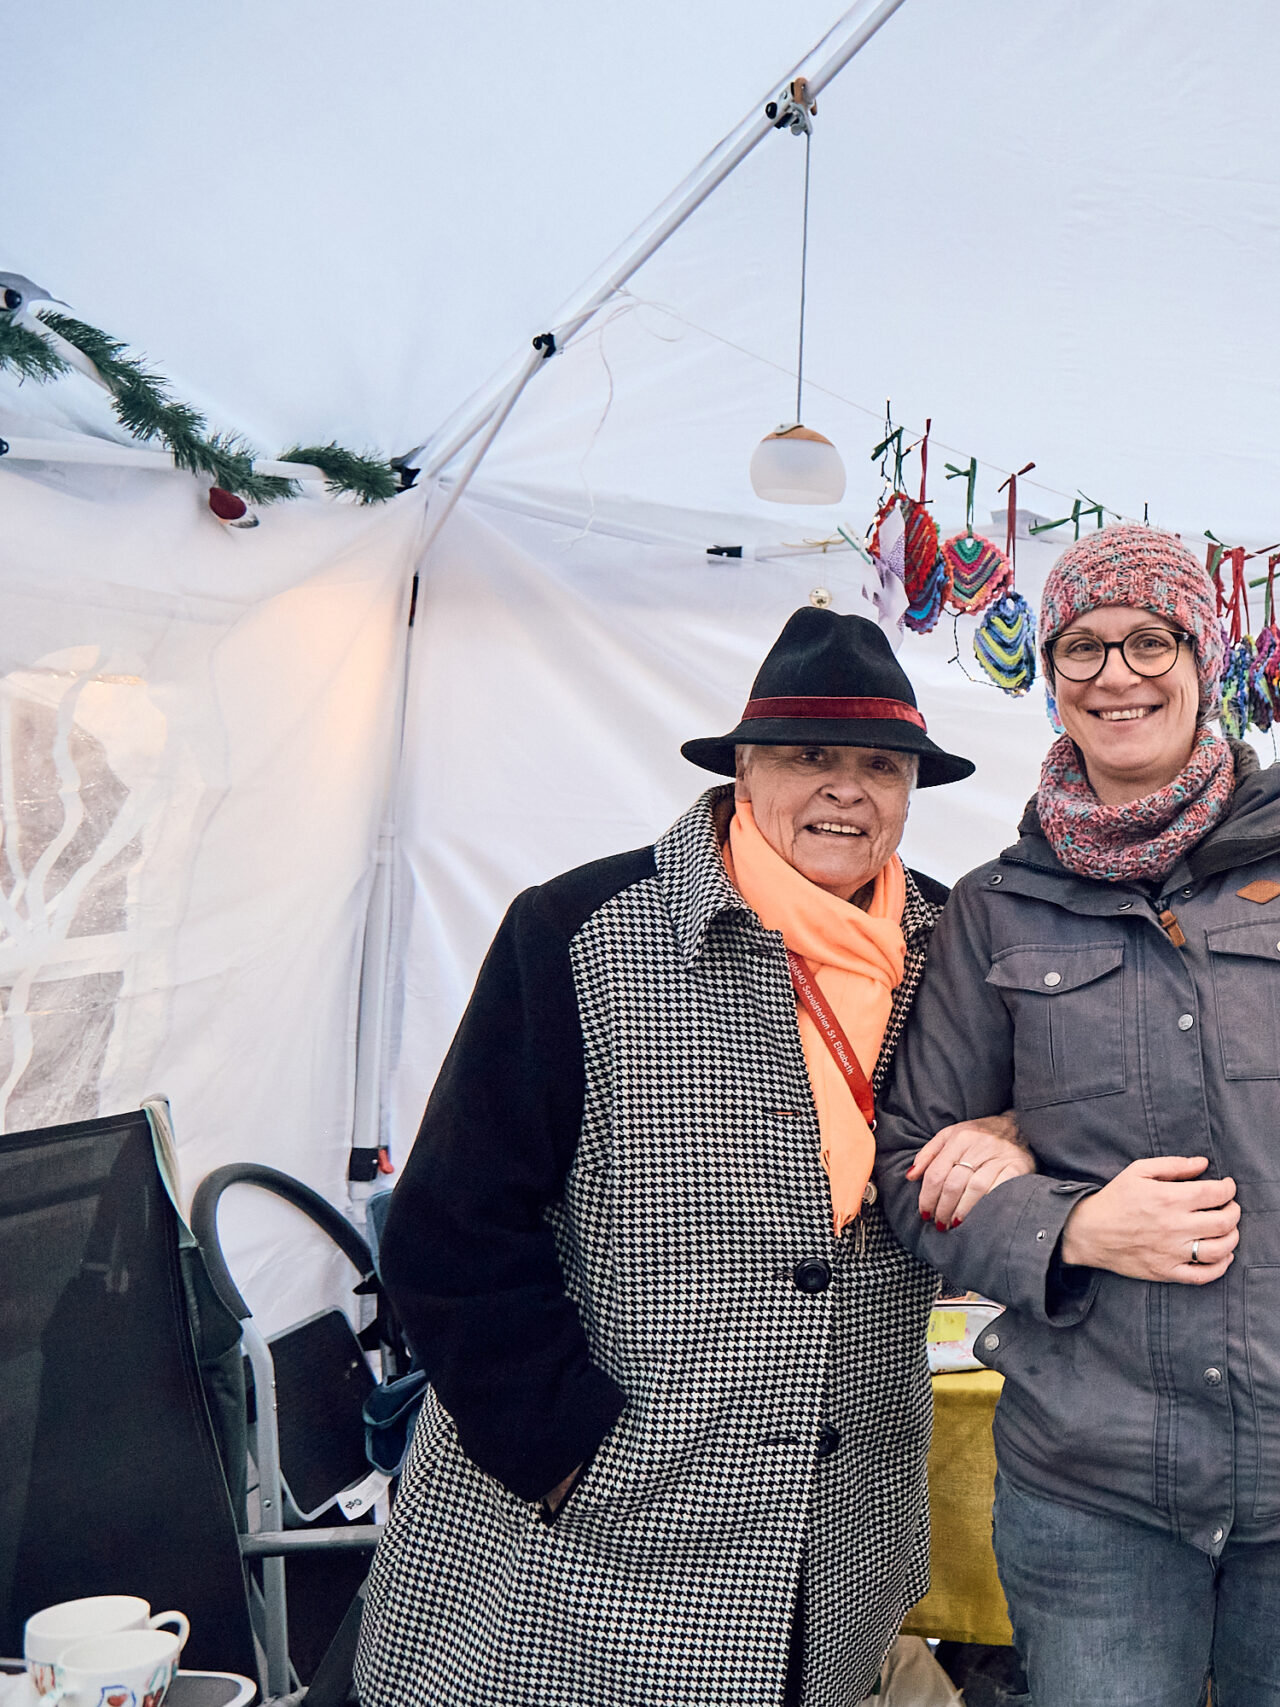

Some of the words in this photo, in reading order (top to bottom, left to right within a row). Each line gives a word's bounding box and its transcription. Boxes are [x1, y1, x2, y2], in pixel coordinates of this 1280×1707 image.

[802, 985, 831, 1030] Sozialstation
[826, 1029, 836, 1042] St.
[833, 1041, 855, 1075] Elisabeth
